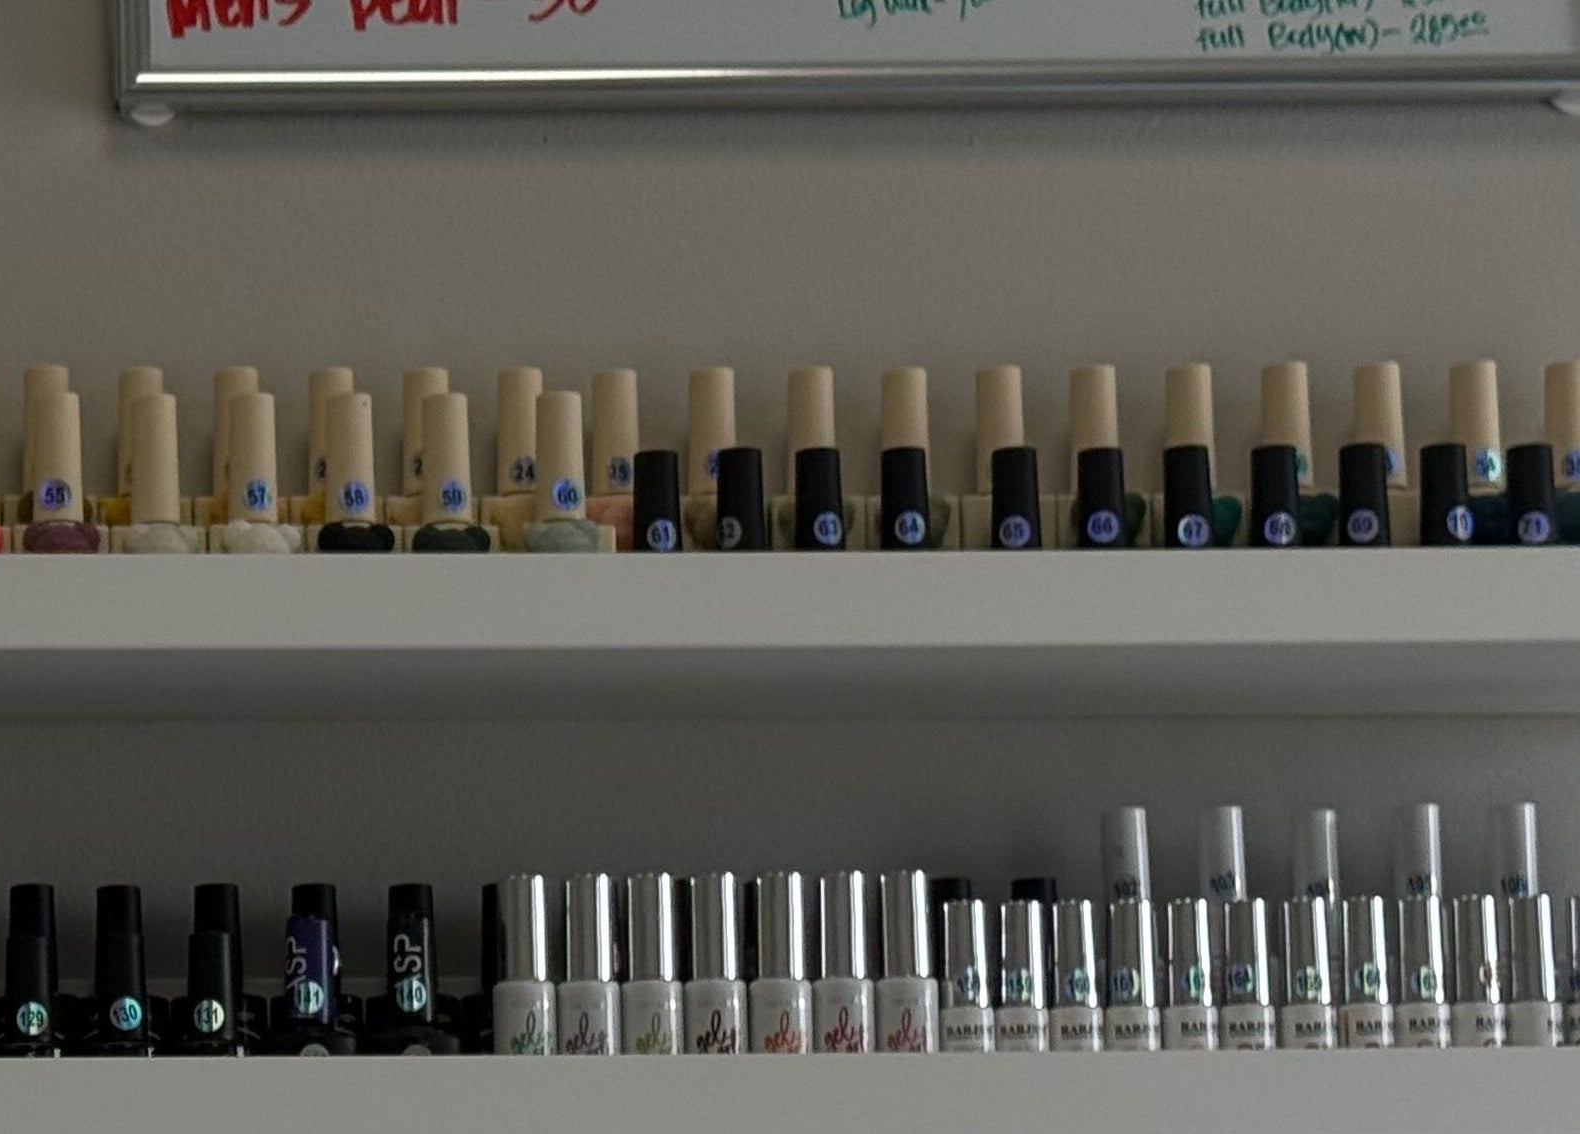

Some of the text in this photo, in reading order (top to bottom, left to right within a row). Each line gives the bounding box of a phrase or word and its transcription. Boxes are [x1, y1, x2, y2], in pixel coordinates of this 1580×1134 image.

[43, 484, 66, 504] 55
[246, 486, 269, 506] 57
[899, 517, 919, 536] 64
[1091, 517, 1113, 536] 66
[1182, 521, 1203, 540] 67
[1352, 516, 1373, 535] 69
[1521, 517, 1543, 536] 71
[20, 1009, 44, 1028] 129
[196, 1007, 219, 1024] 131
